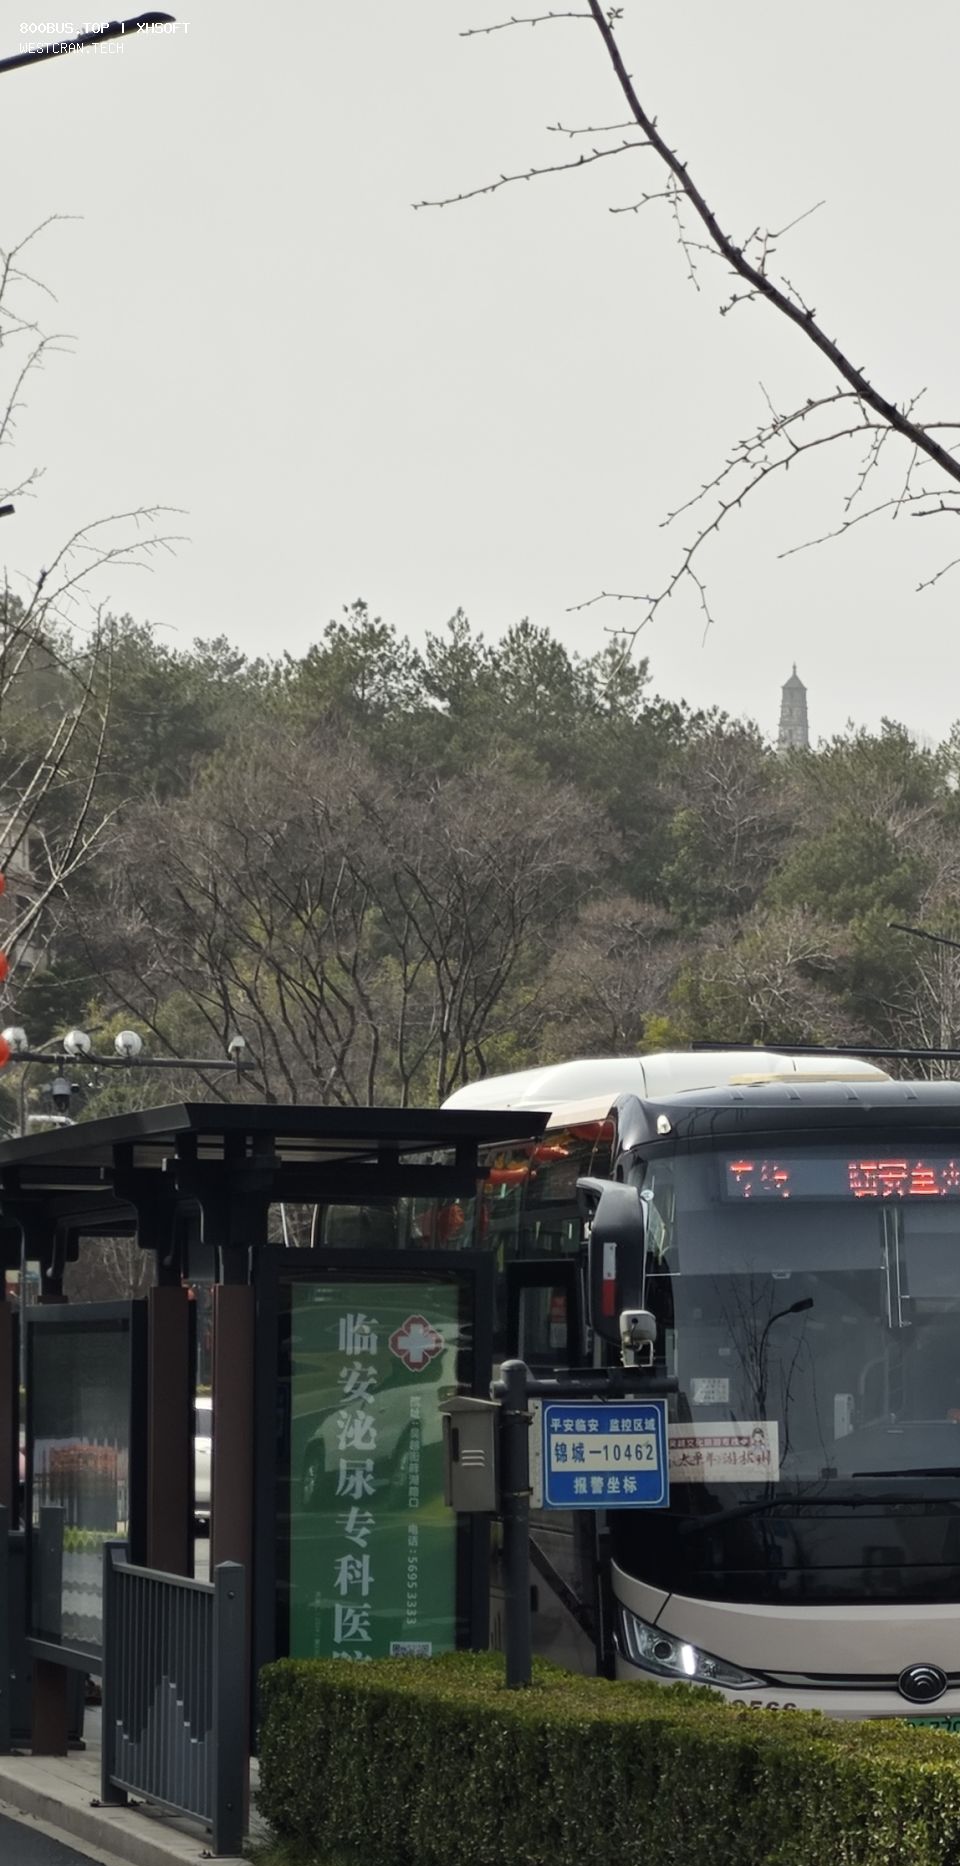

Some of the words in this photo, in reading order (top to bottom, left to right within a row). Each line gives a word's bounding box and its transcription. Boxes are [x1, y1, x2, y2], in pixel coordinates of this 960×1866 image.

[550, 1417, 600, 1433] 平安临安
[608, 1417, 657, 1433] 监控区域
[332, 1312, 379, 1660] 临安泌尿专科医
[573, 1475, 639, 1495] 报警坐标
